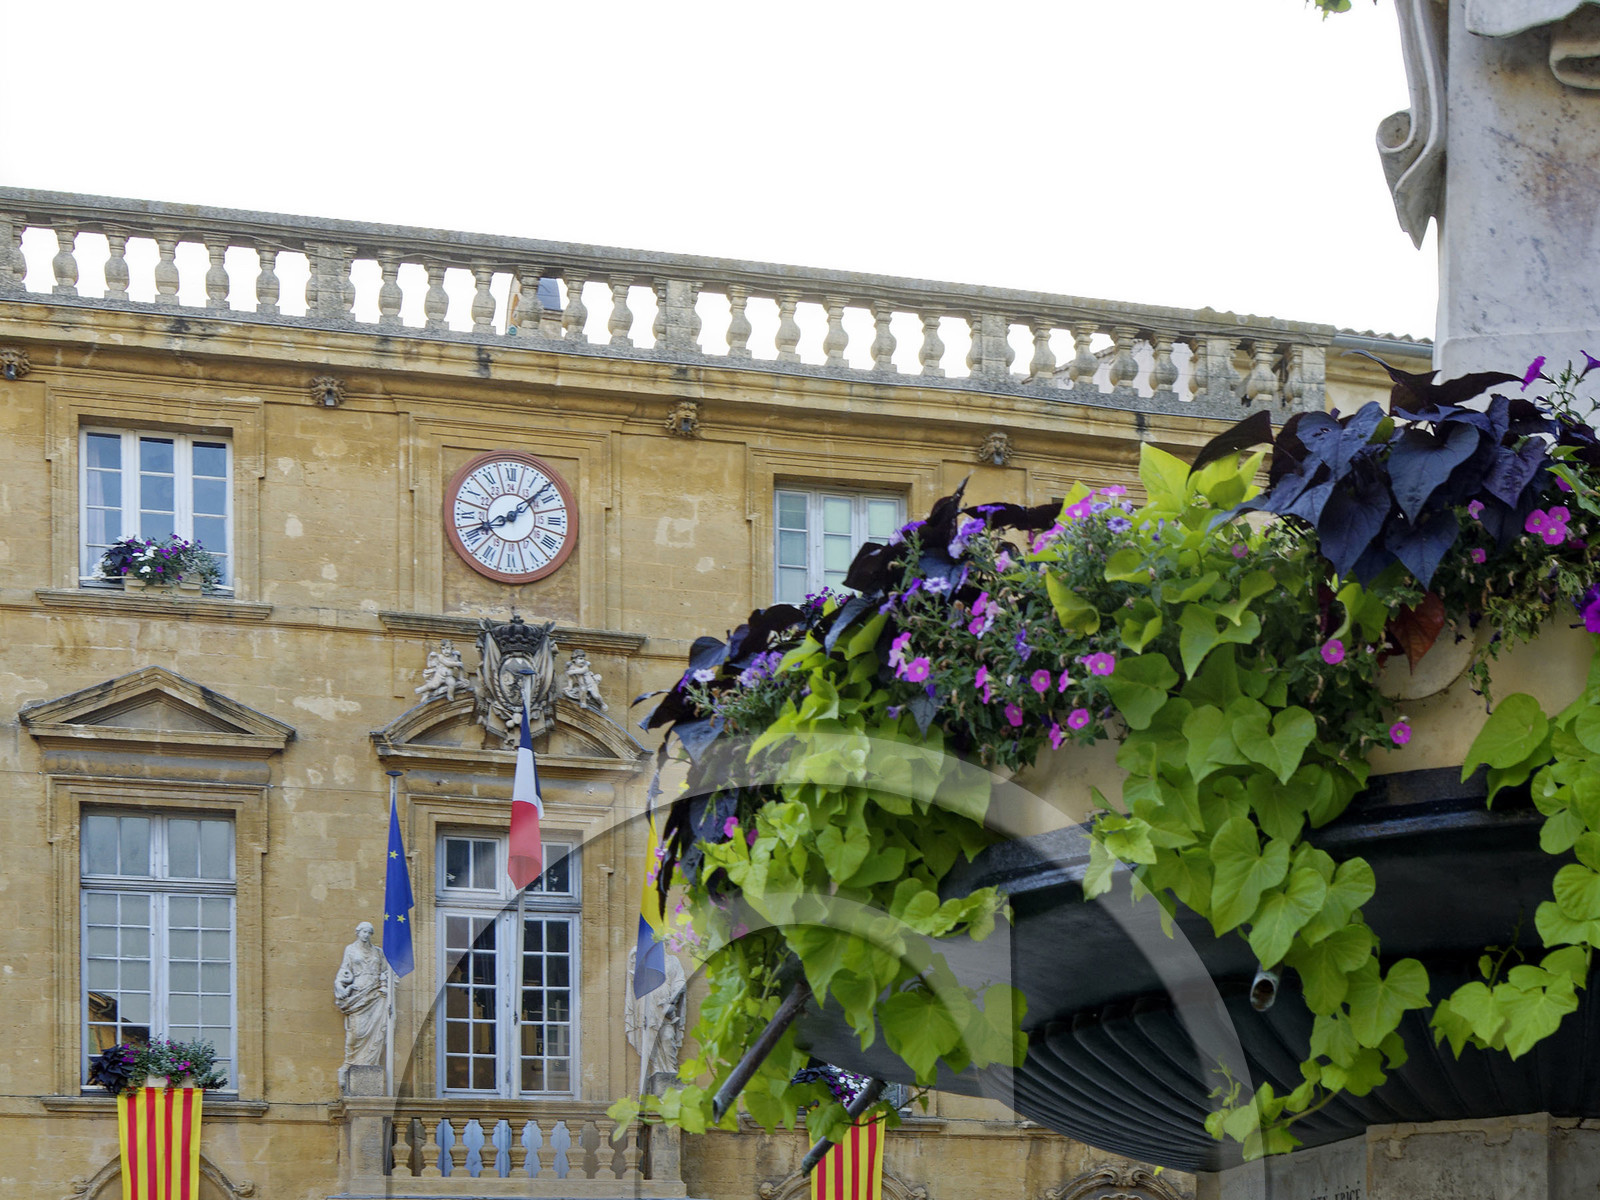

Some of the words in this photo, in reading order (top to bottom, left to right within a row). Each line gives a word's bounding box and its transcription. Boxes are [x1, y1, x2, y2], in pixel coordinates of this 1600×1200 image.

[507, 483, 515, 492] 24
[541, 494, 555, 504] II
[547, 516, 561, 526] III
